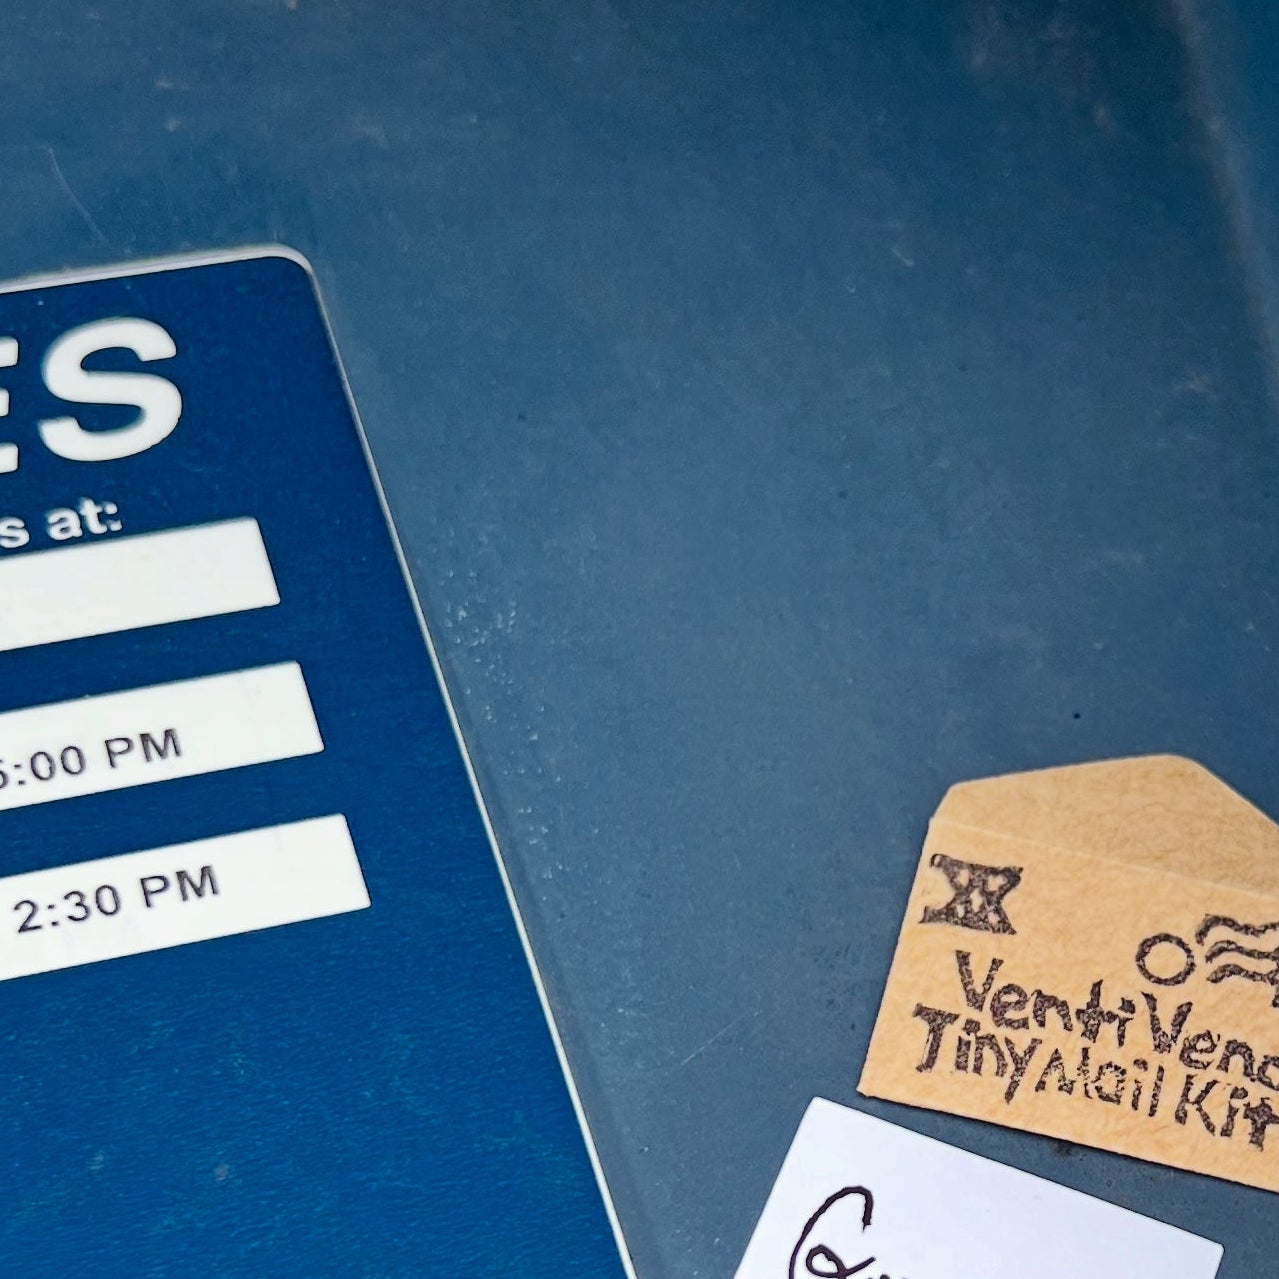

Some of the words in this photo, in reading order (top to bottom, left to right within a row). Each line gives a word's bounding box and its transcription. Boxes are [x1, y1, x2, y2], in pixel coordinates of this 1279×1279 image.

[0, 316, 182, 474] S
[46, 497, 123, 541] at:
[104, 728, 182, 769] PM
[13, 884, 122, 933] 2:30
[140, 865, 220, 909] PM
[954, 949, 1138, 1047] Venti
[912, 1003, 1042, 1104] Tiny
[1034, 1047, 1165, 1118] Mail
